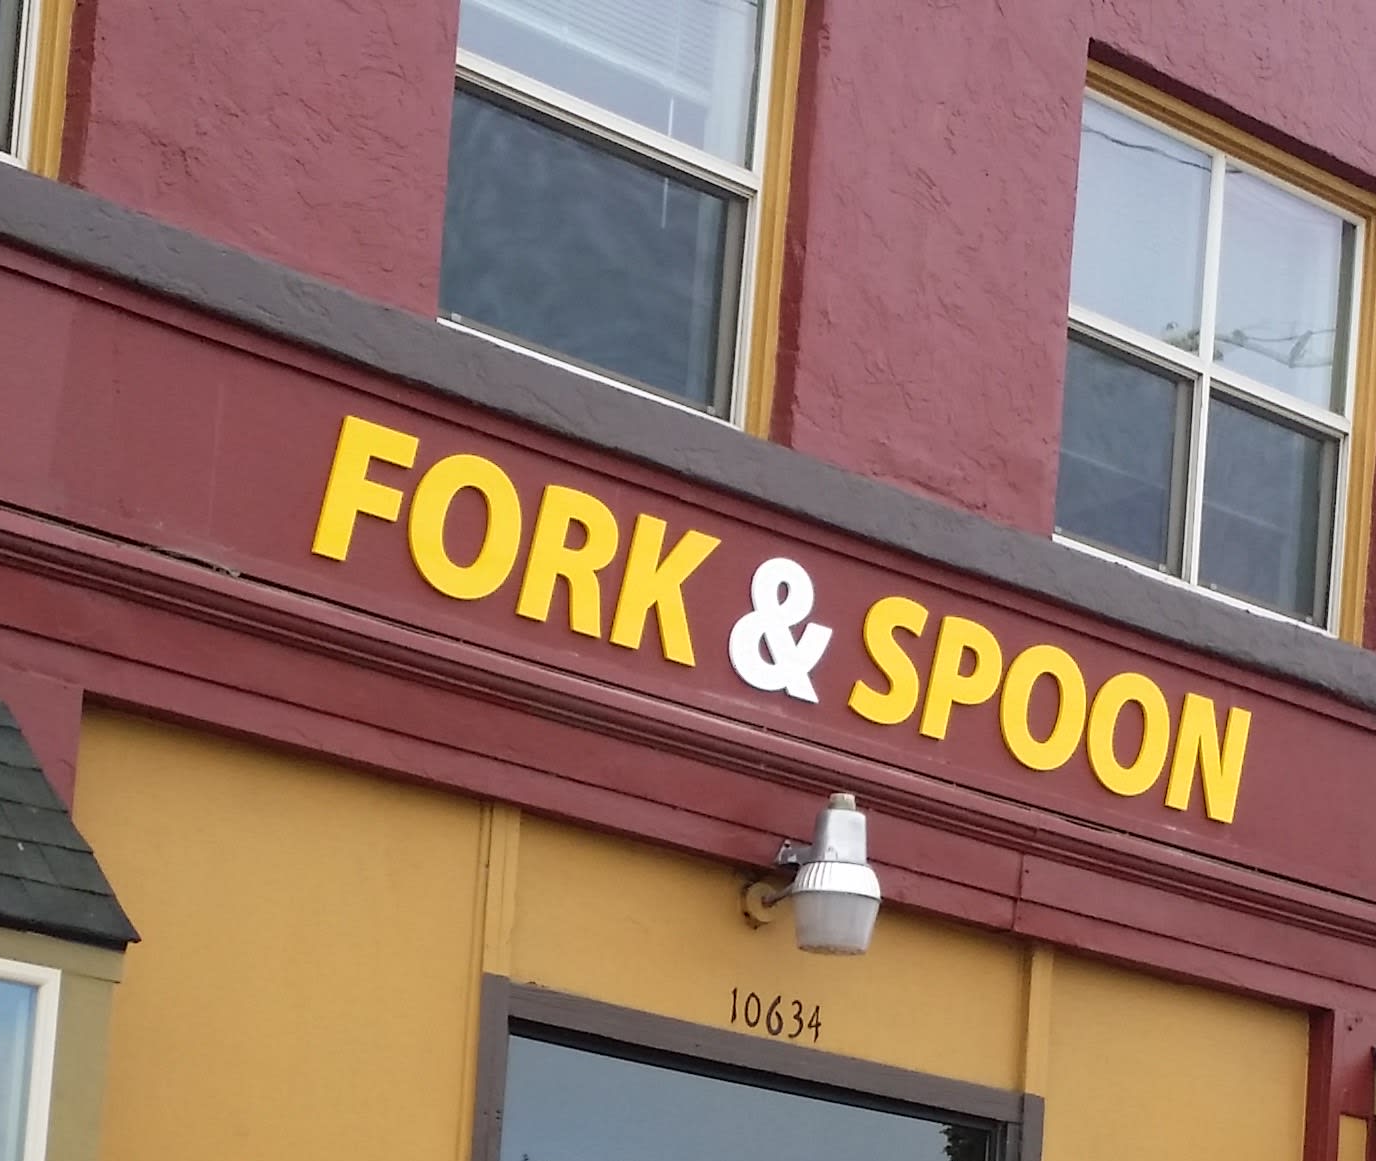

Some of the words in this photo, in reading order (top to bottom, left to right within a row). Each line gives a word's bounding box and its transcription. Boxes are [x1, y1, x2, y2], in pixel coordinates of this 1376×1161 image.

[310, 413, 722, 668] FORK
[727, 557, 833, 703] &
[847, 596, 1252, 824] SPOON
[730, 987, 822, 1043] 10634
